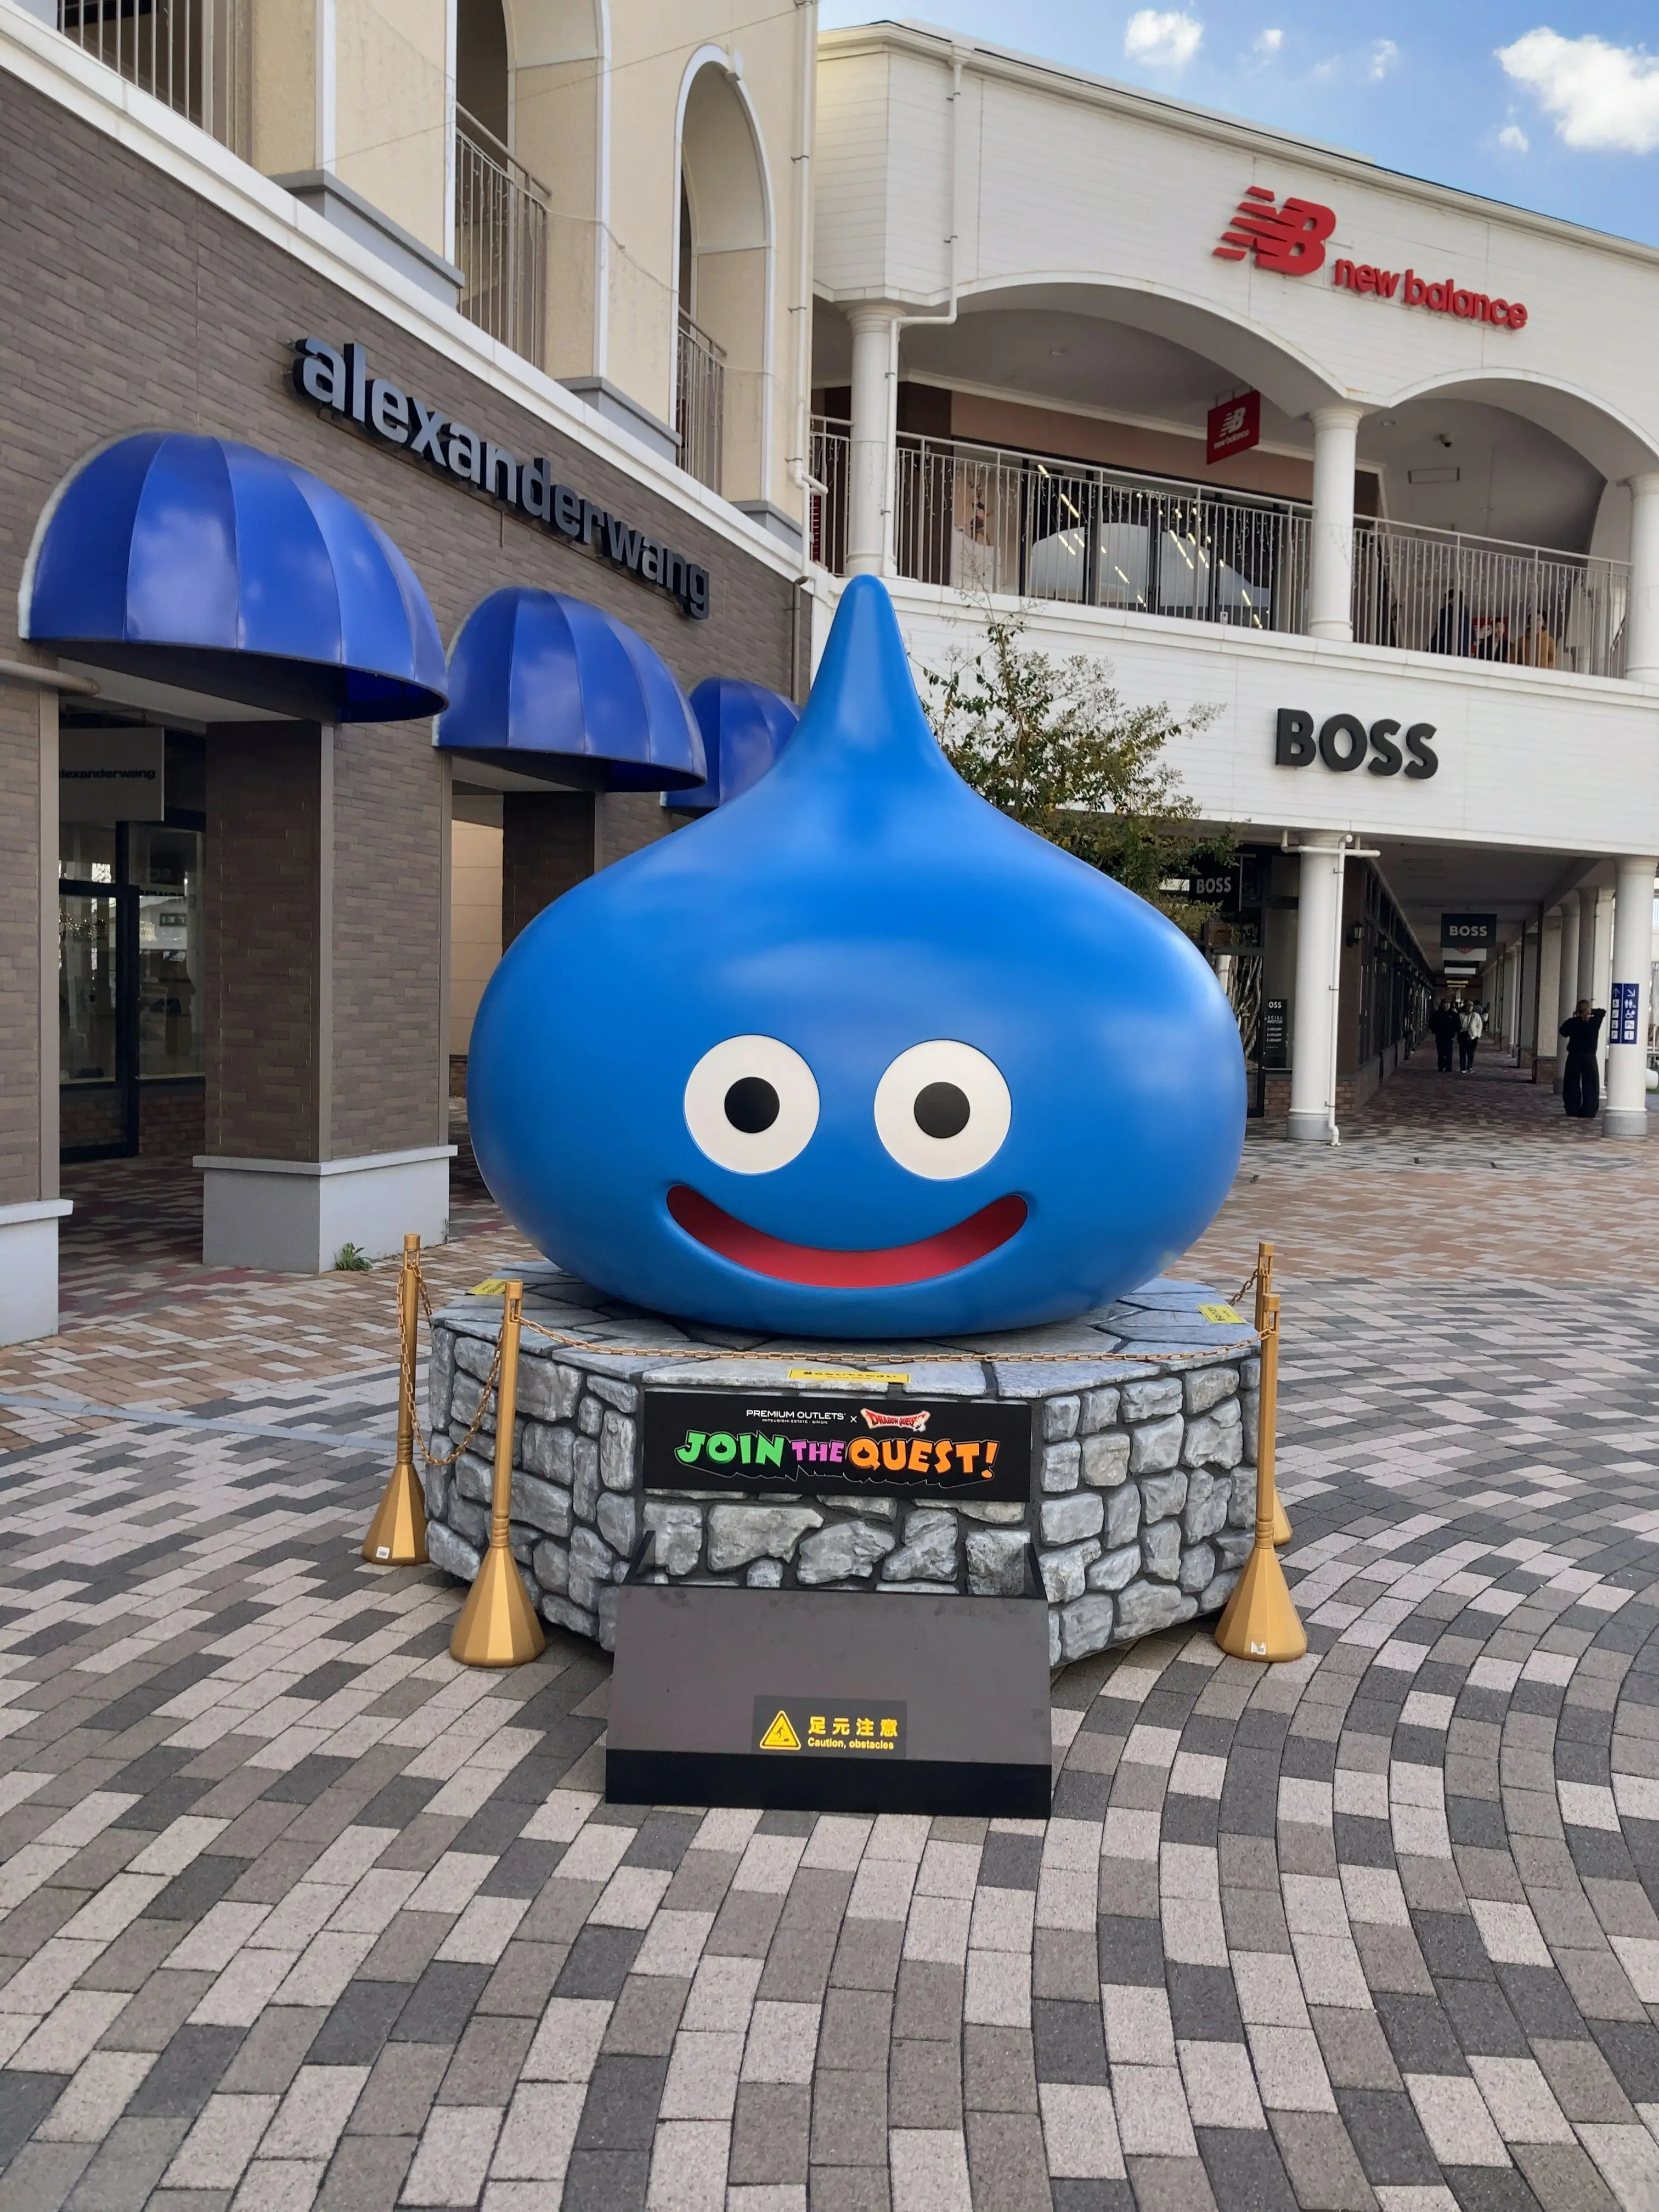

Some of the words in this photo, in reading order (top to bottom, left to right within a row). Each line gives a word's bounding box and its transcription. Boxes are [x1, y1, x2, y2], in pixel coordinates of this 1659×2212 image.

[1334, 257, 1400, 298] new
[1404, 268, 1528, 331] balance
[292, 337, 710, 620] alexanderwang
[1275, 708, 1438, 780] BOSS
[59, 768, 156, 780] lexanderwang
[1196, 876, 1232, 894] BOSS
[1449, 925, 1488, 937] BOSS
[746, 1409, 795, 1418] PREMIUM
[675, 1430, 785, 1467] JOIN
[792, 1440, 844, 1464] THE
[848, 1436, 1001, 1480] QUEST!
[808, 1716, 898, 1737] 足元注意
[807, 1736, 847, 1750] Caution,
[849, 1739, 894, 1751] obstacles
